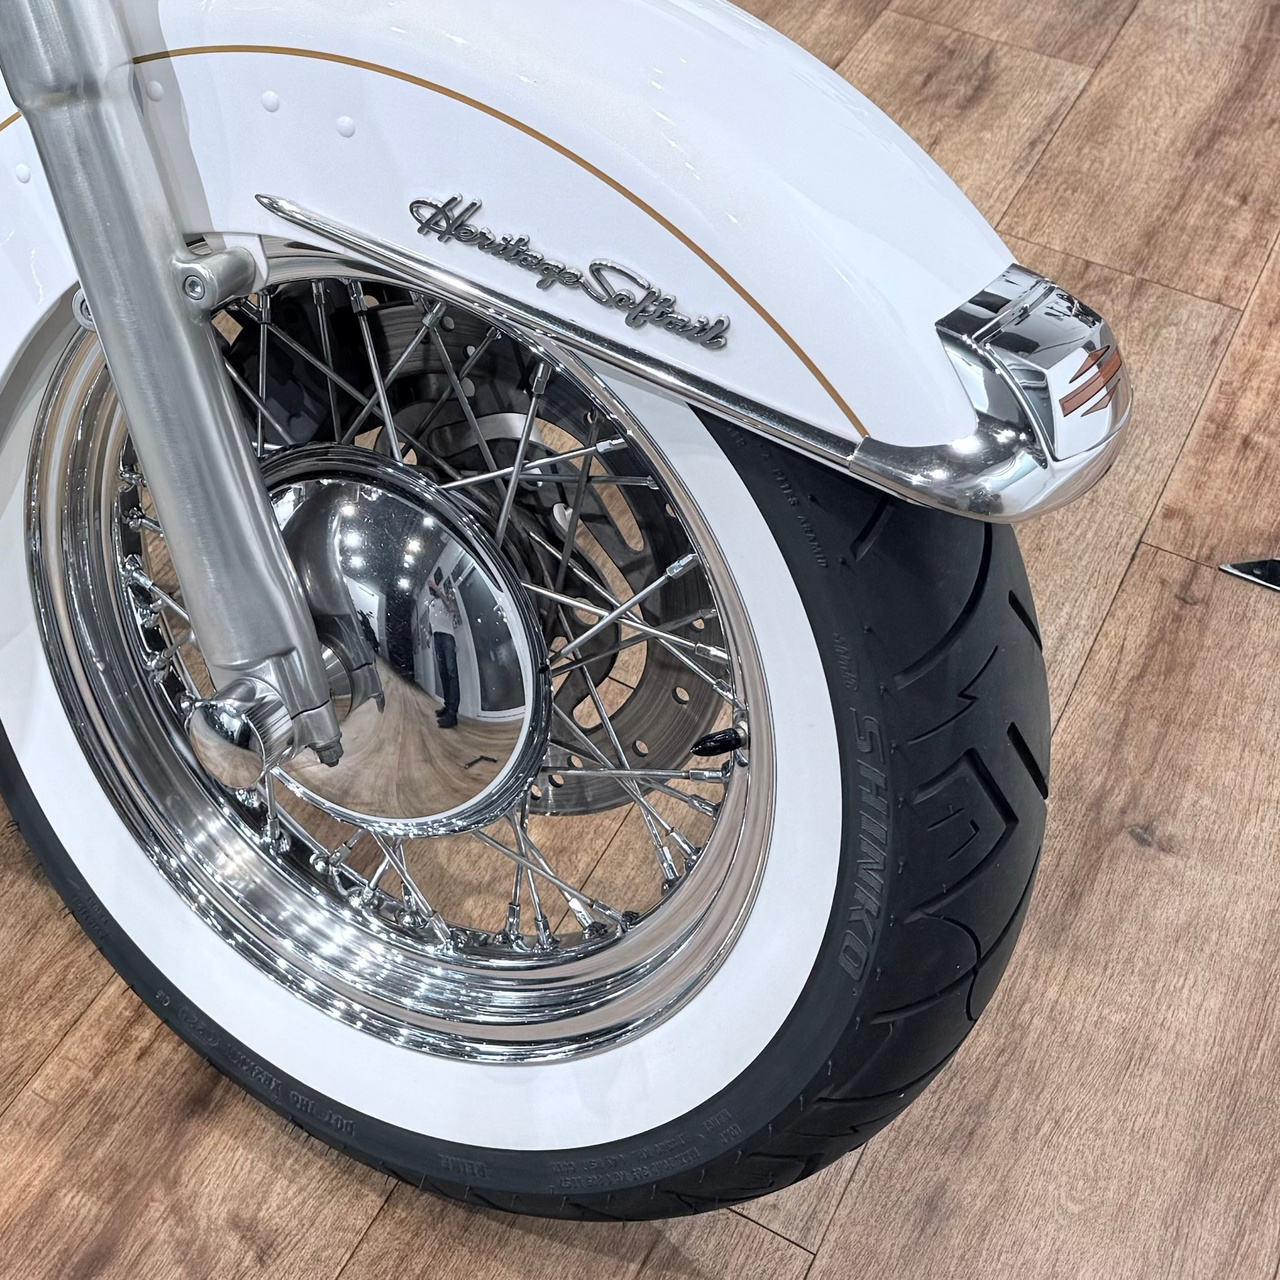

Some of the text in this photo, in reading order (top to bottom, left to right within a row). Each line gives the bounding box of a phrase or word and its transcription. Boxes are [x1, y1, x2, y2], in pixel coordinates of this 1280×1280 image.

[408, 192, 731, 350] Heritage Softail
[838, 707, 889, 982] SHINKO
